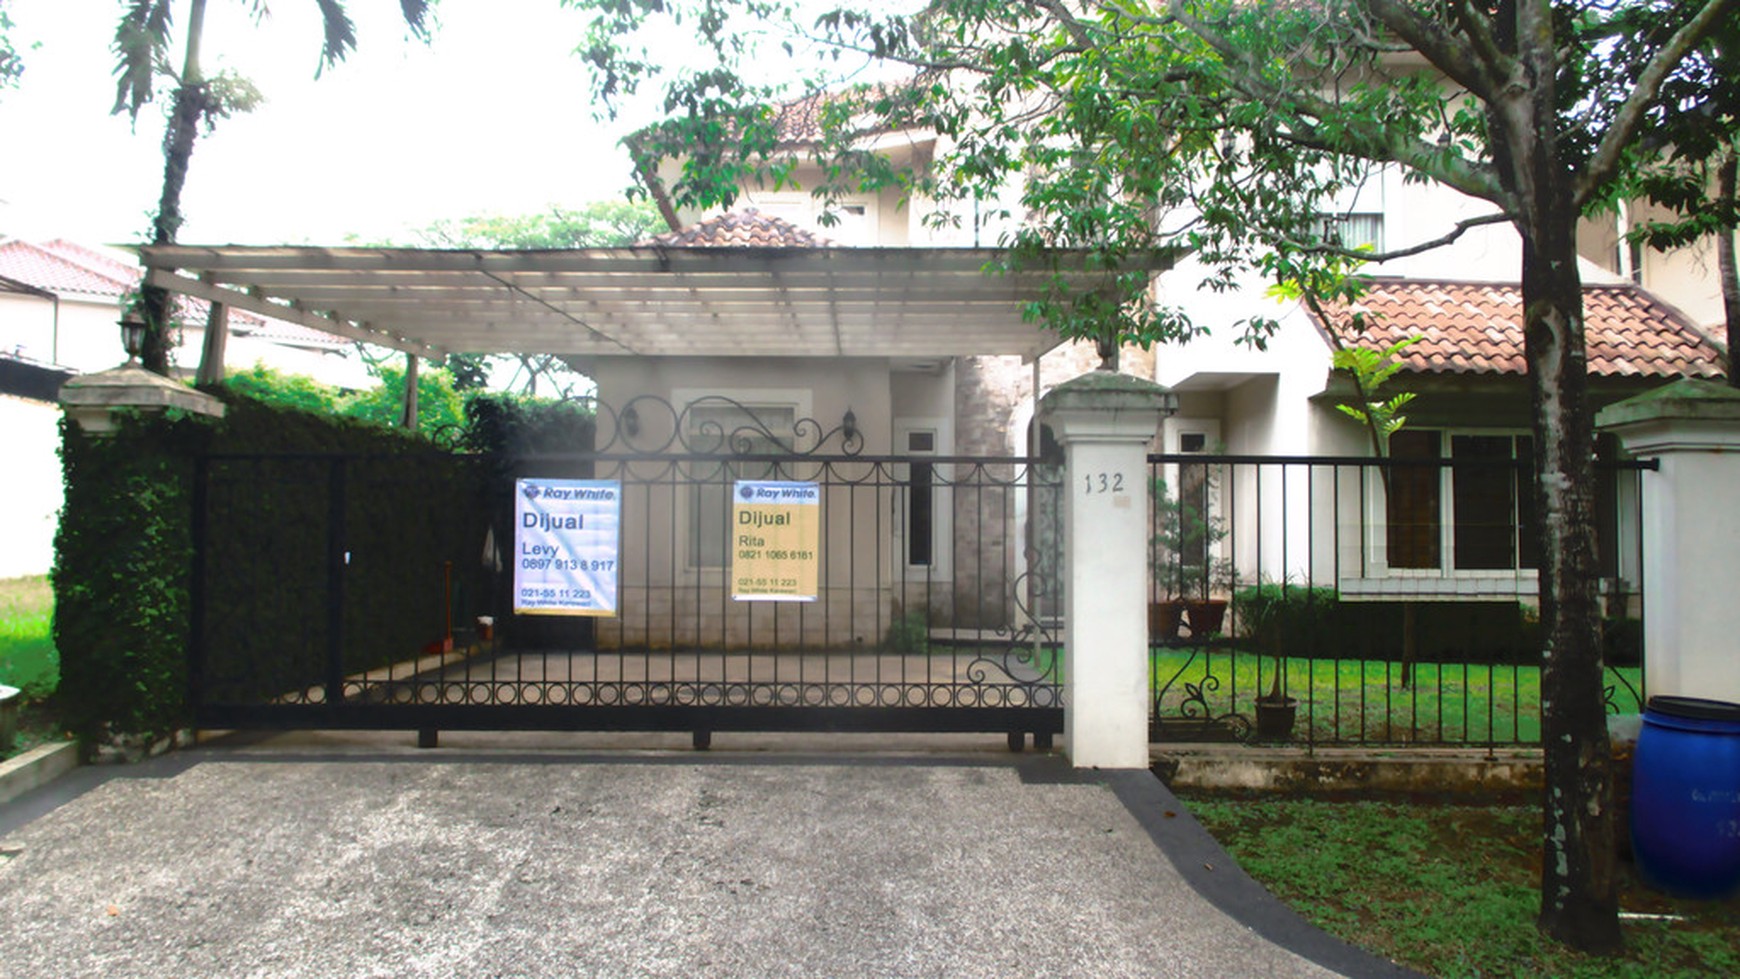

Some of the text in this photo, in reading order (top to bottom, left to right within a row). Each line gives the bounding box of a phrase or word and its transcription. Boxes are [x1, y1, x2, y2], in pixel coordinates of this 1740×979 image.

[1085, 472, 1124, 494] 132
[543, 488, 615, 500] Ray White
[756, 488, 815, 499] Ray White
[523, 512, 584, 532] Dijual
[739, 511, 791, 528] Dijual
[739, 535, 765, 547] Rita
[522, 542, 559, 558] Levy
[555, 559, 578, 570] 913
[579, 560, 588, 571] 8
[591, 561, 614, 571] 917
